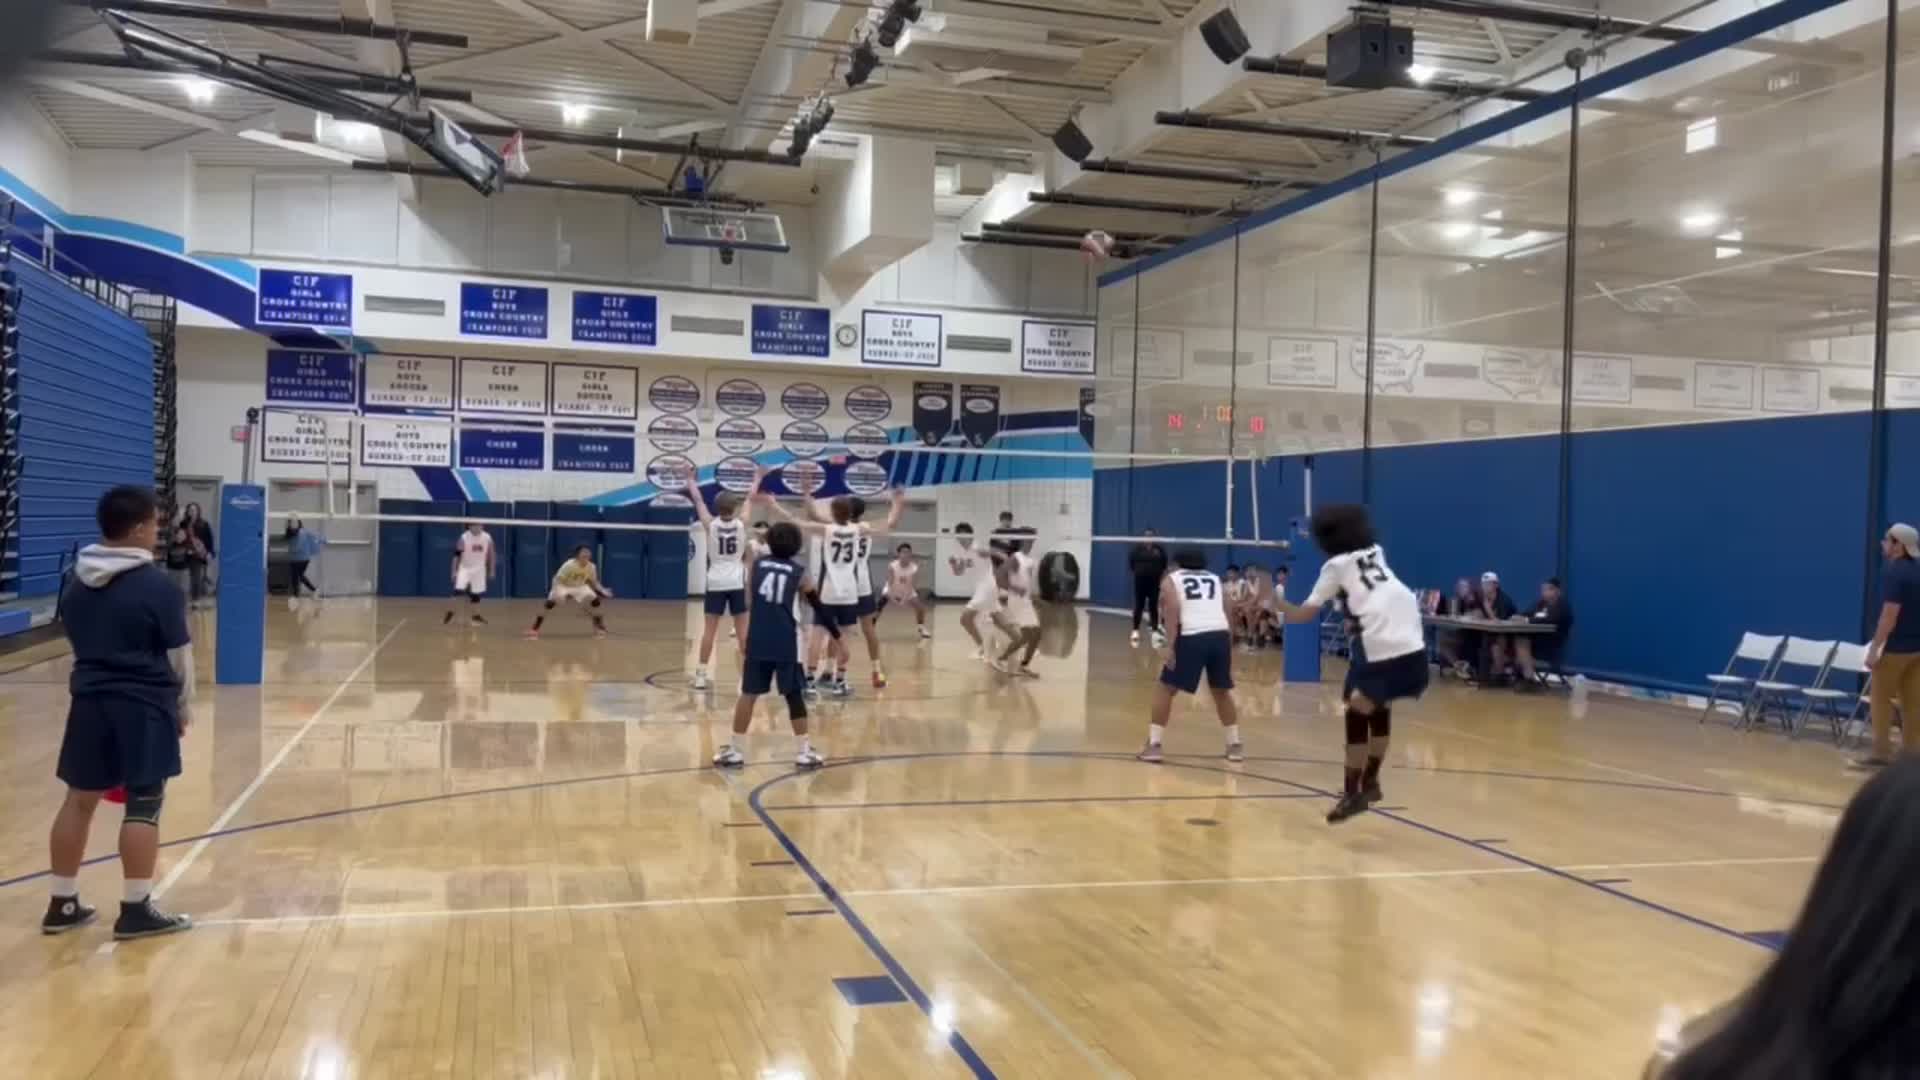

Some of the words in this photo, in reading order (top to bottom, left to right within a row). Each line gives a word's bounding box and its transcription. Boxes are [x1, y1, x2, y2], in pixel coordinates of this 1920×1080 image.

[718, 537, 737, 555] 16
[831, 542, 853, 563] 73
[759, 572, 787, 604] 41
[1183, 578, 1215, 600] 27
